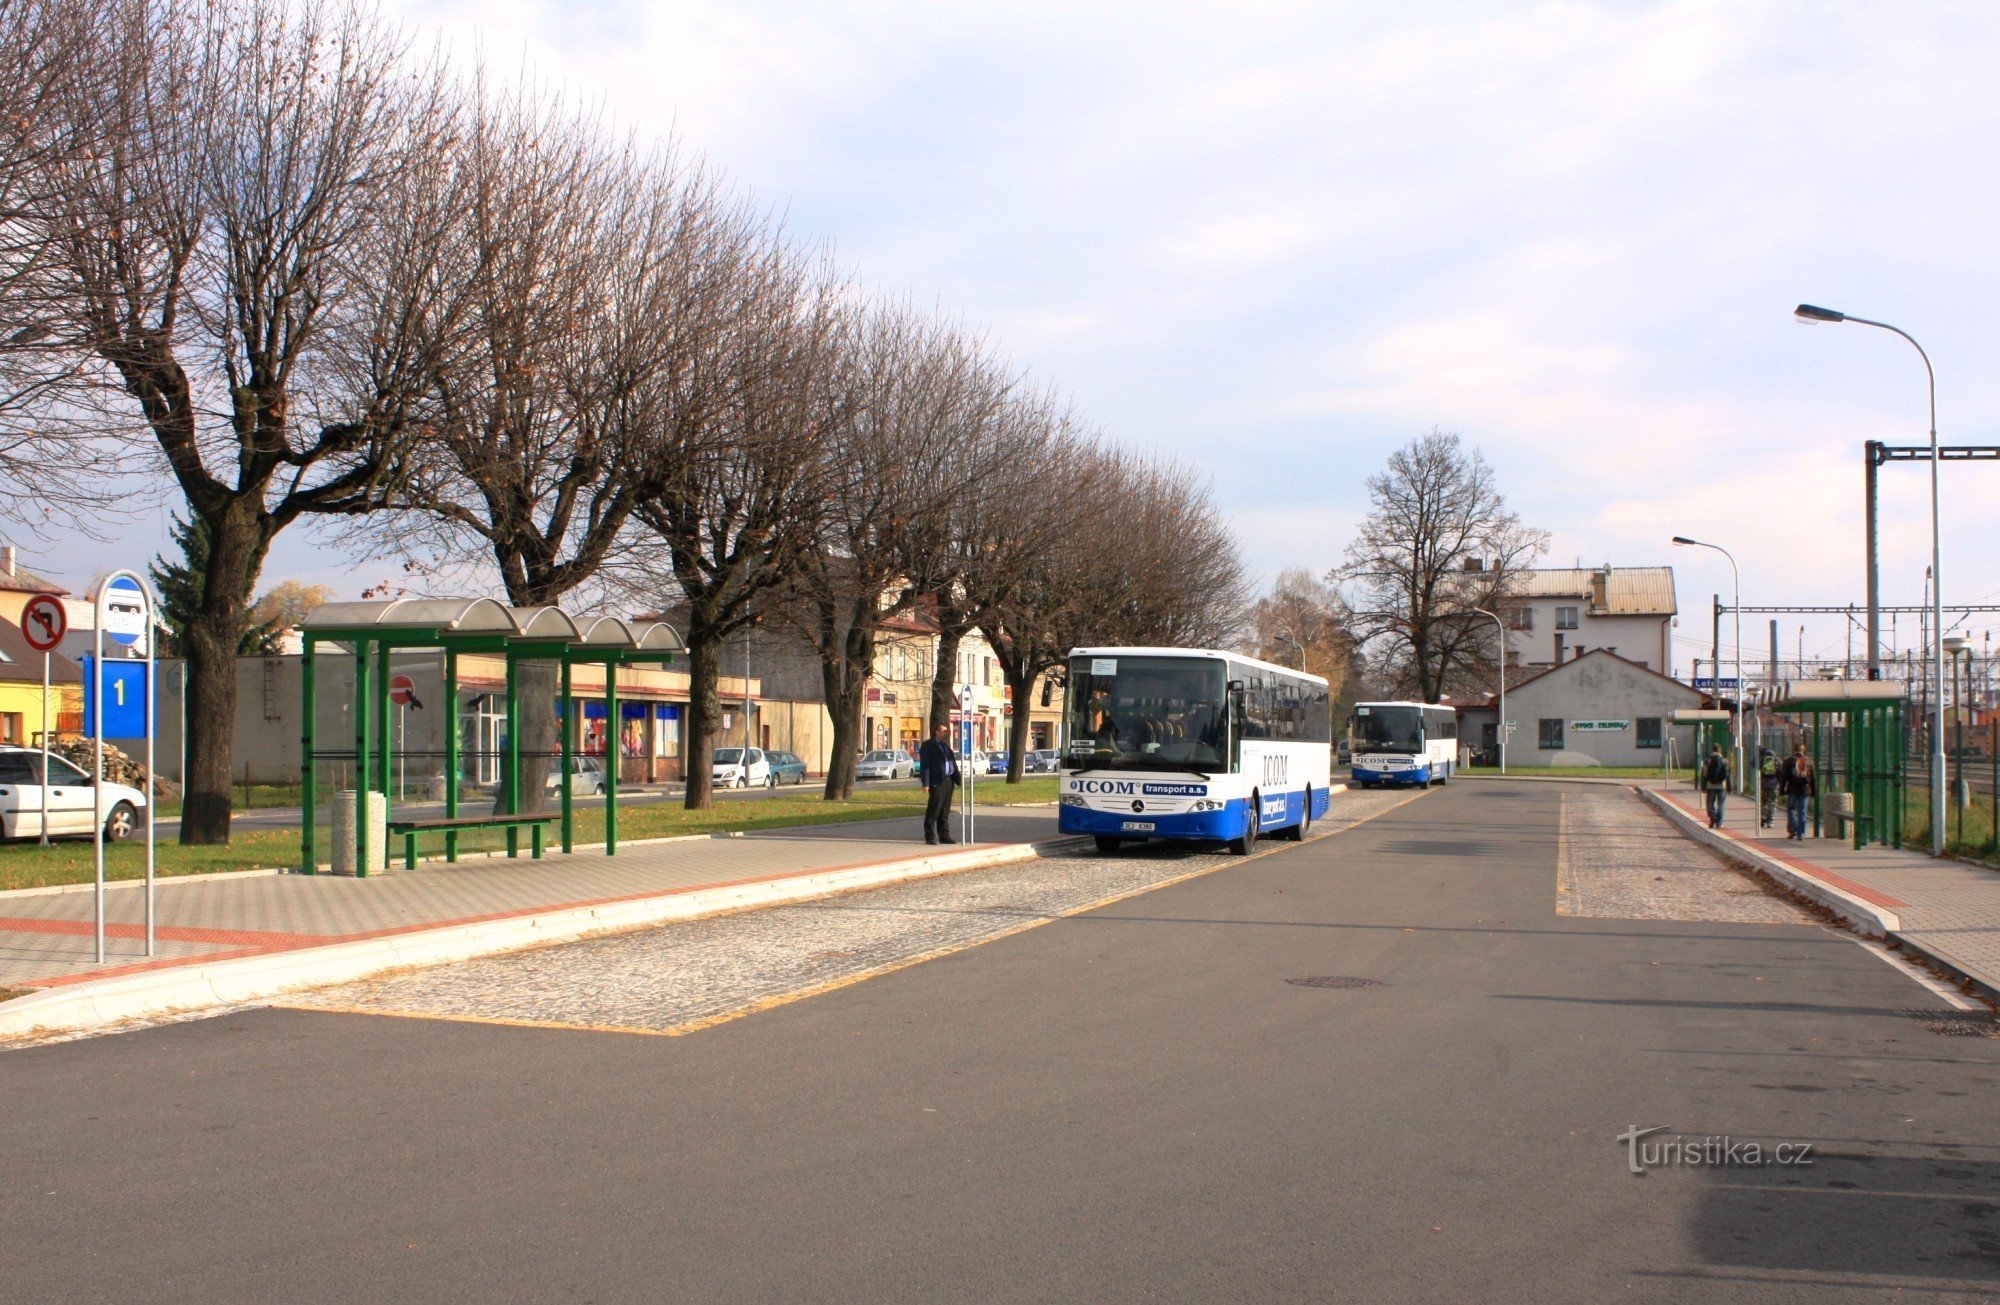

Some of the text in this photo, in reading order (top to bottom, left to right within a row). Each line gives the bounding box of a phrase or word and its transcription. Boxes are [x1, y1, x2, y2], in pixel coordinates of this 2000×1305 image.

[113, 678, 124, 706] 1
[1262, 754, 1288, 787] ICOM
[1077, 780, 1136, 795] ICOM
[1145, 785, 1187, 795] transport
